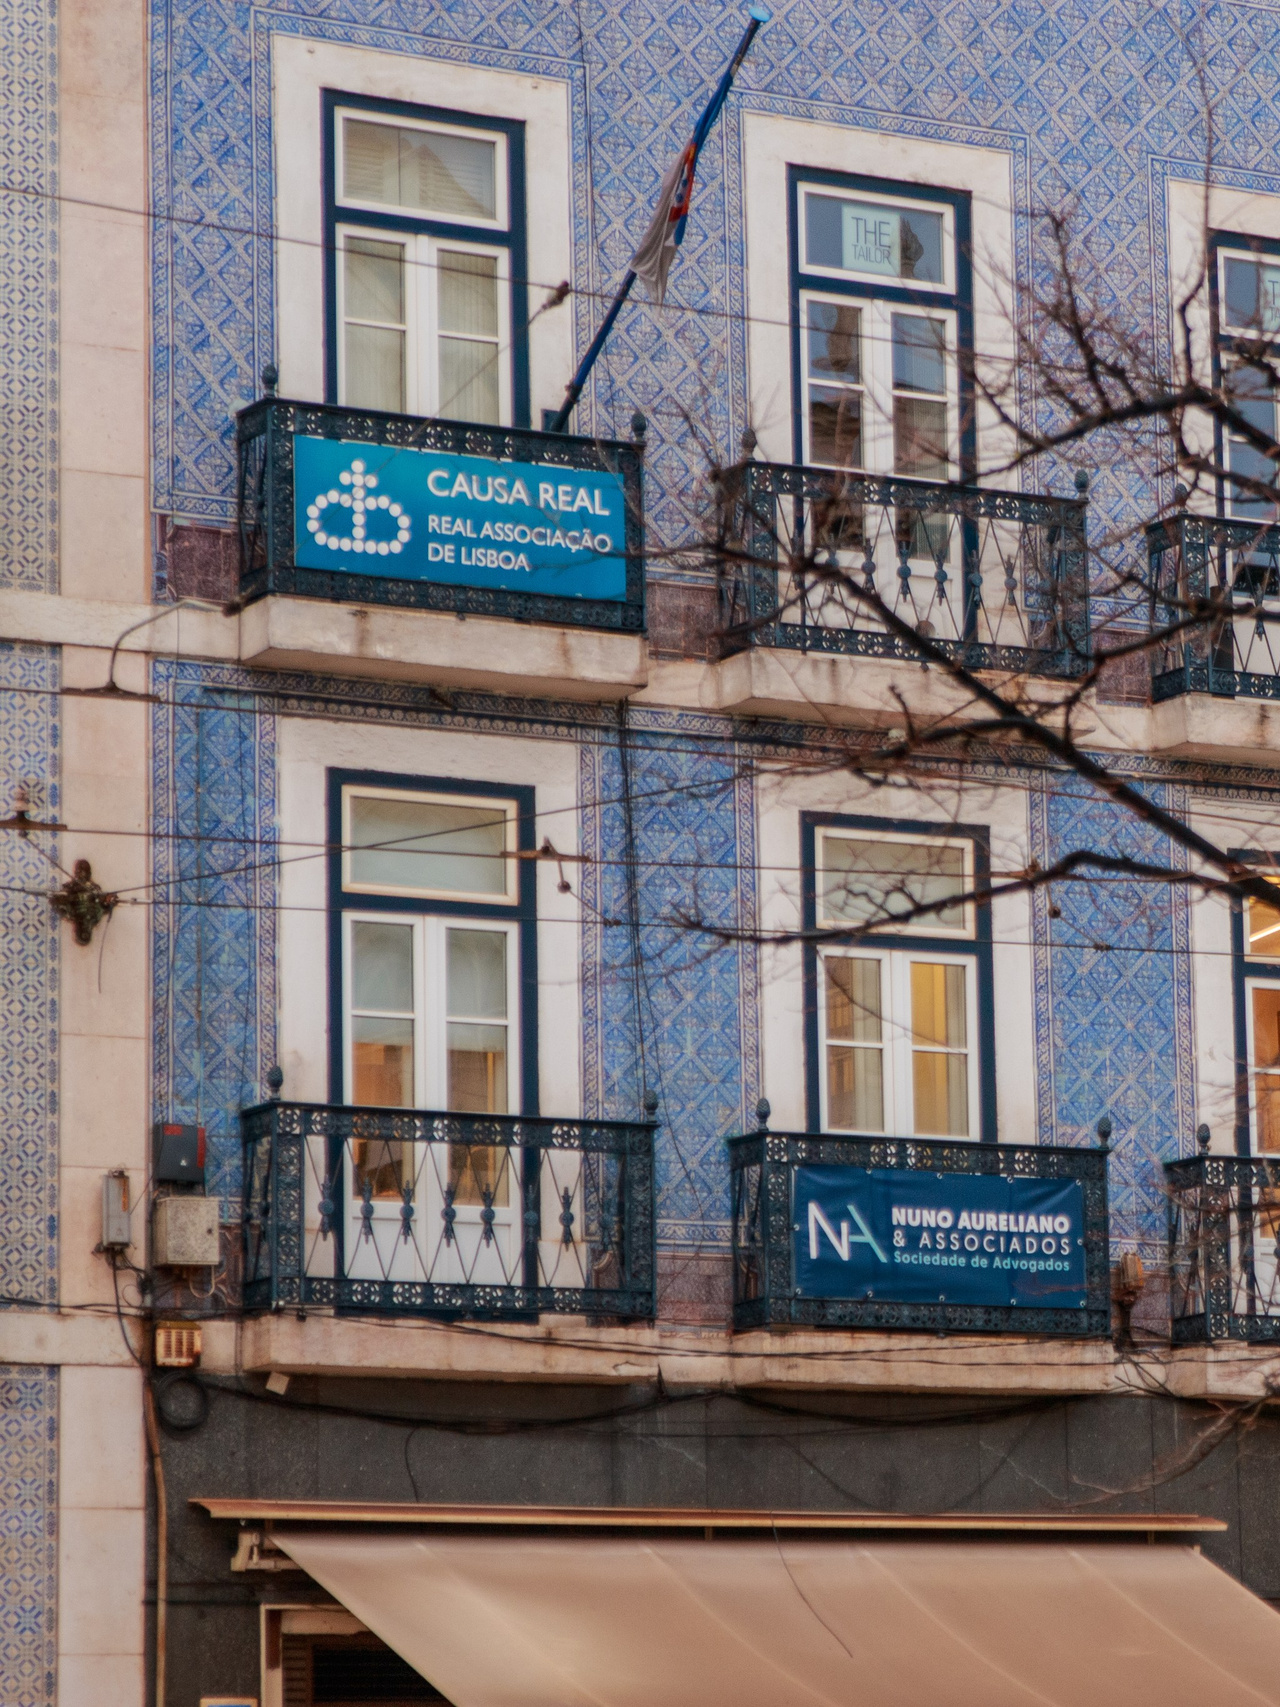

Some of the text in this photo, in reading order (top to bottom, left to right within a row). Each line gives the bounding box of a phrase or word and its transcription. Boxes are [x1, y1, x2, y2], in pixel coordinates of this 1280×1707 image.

[851, 216, 892, 249] THE
[852, 243, 892, 265] TAILOR
[427, 469, 612, 517] CAUSA REAL
[428, 515, 613, 553] REAL ASSOCIAÇÃO
[428, 544, 530, 572] DE LISBOA
[891, 1206, 1071, 1235] NUNO AURELIANO
[892, 1229, 1070, 1256] & ASSOCIADOS
[893, 1251, 1070, 1273] Sociedade de Advogados
